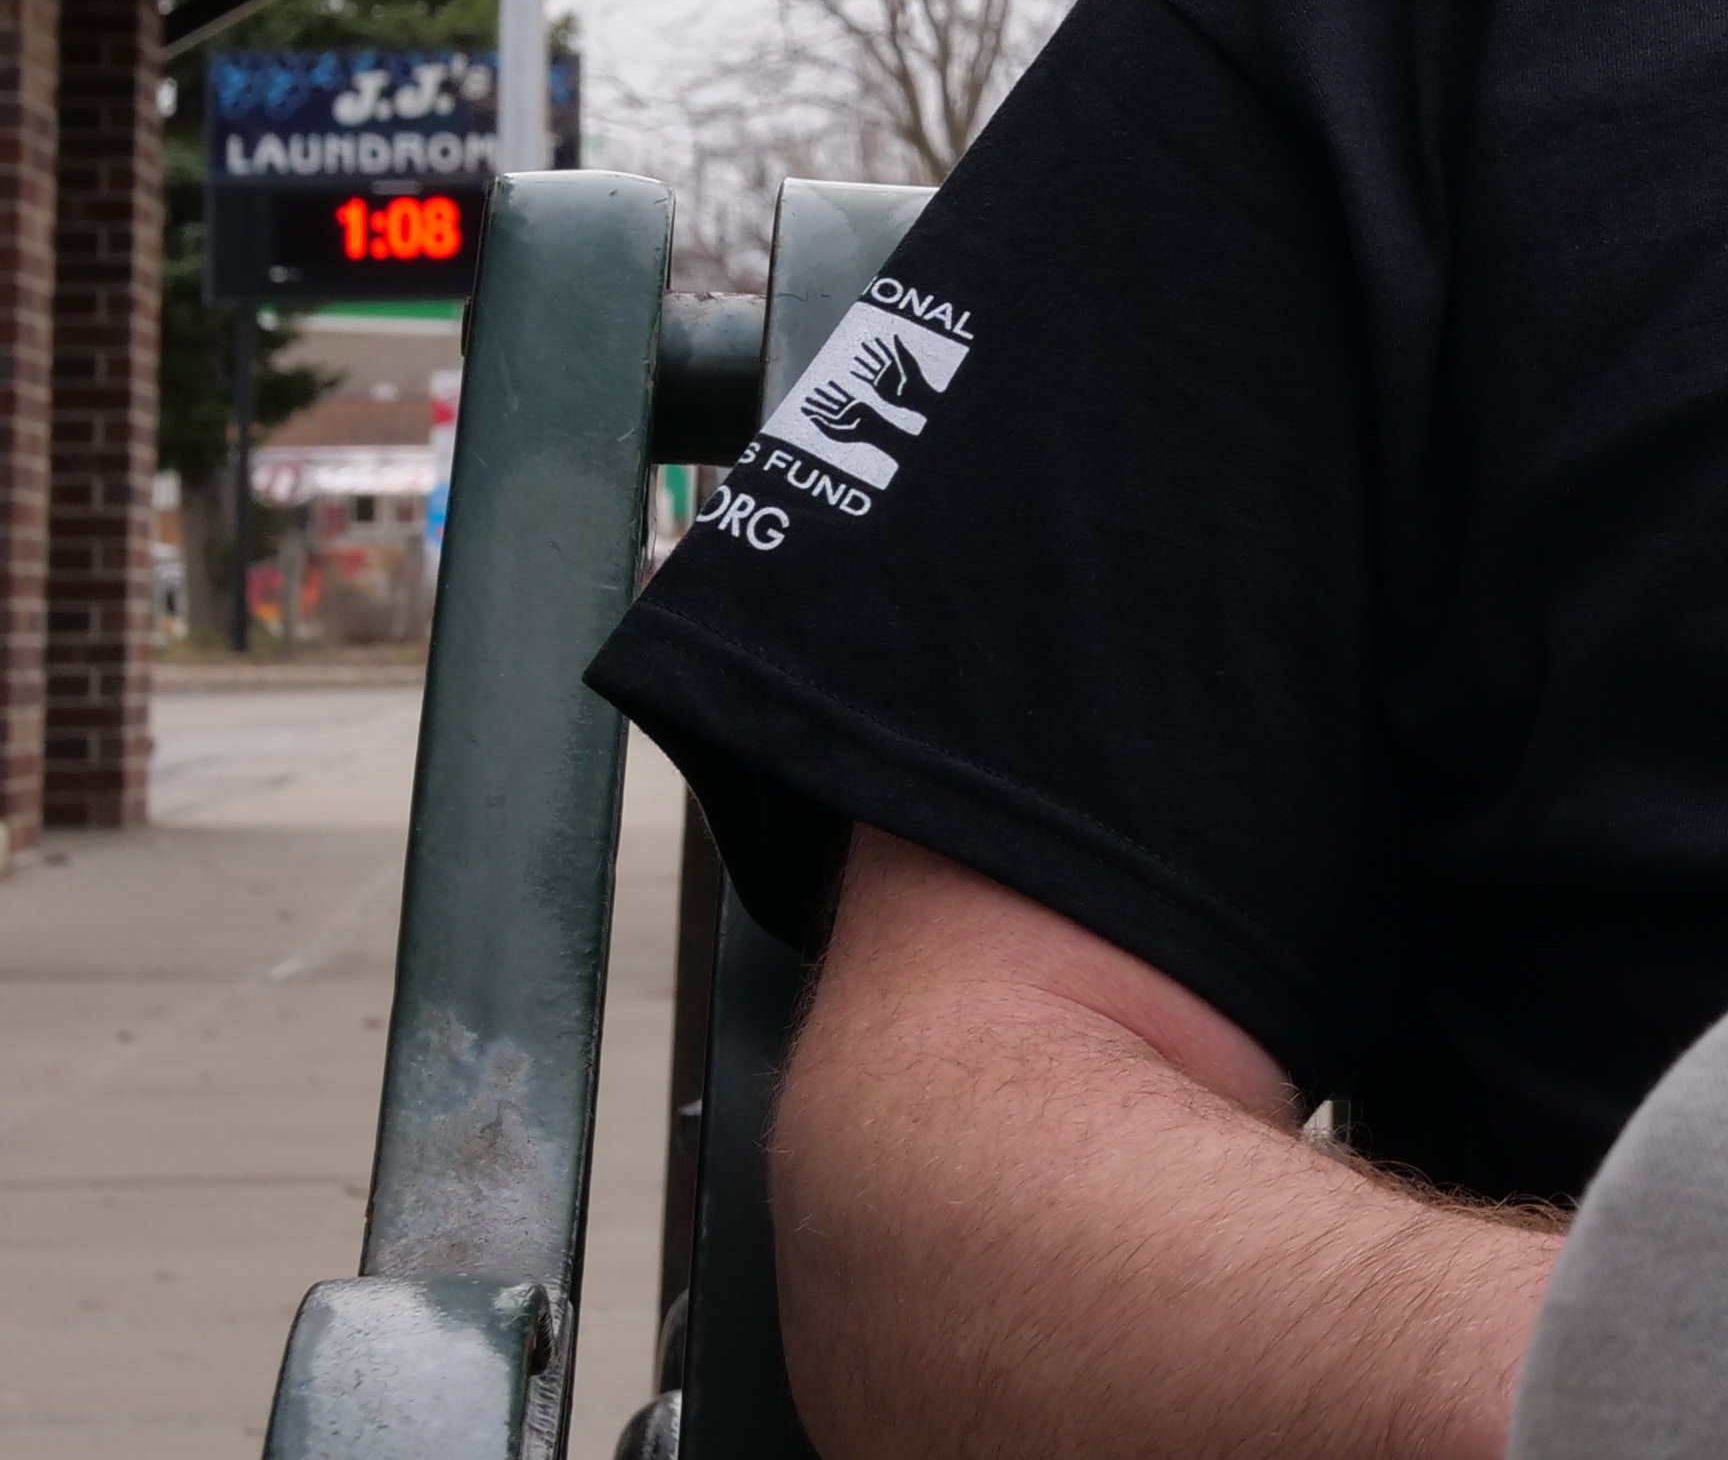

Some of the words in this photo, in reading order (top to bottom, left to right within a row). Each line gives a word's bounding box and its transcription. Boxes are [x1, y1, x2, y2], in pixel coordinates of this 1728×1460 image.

[225, 132, 556, 175] LAUNDROM
[337, 197, 462, 260] 1:08
[763, 450, 872, 516] FUND
